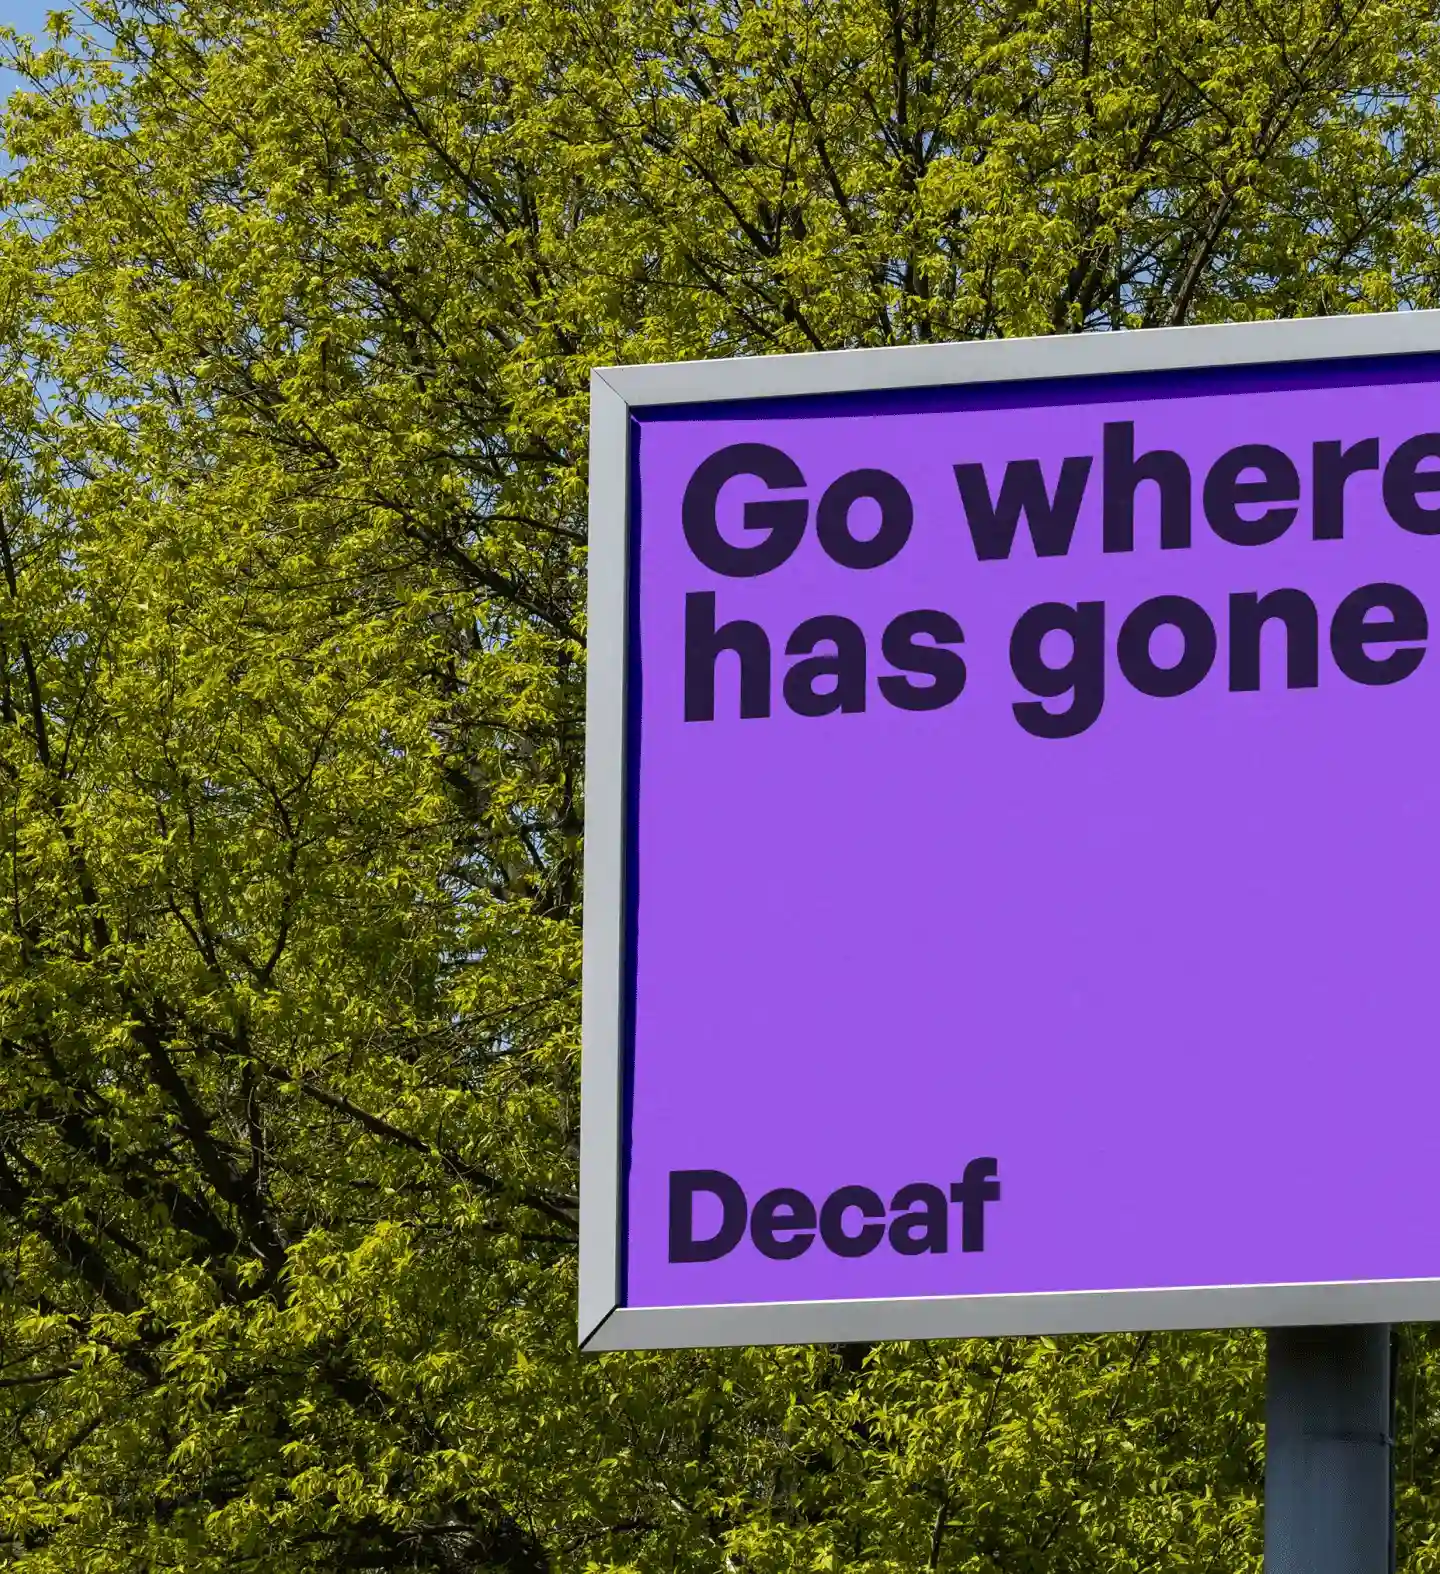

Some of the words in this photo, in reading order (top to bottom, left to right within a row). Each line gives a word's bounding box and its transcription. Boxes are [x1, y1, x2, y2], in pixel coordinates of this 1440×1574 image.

[681, 442, 914, 578] Go
[684, 590, 967, 723] has
[1009, 582, 1429, 739] gone
[668, 1156, 1001, 1264] Decaf
